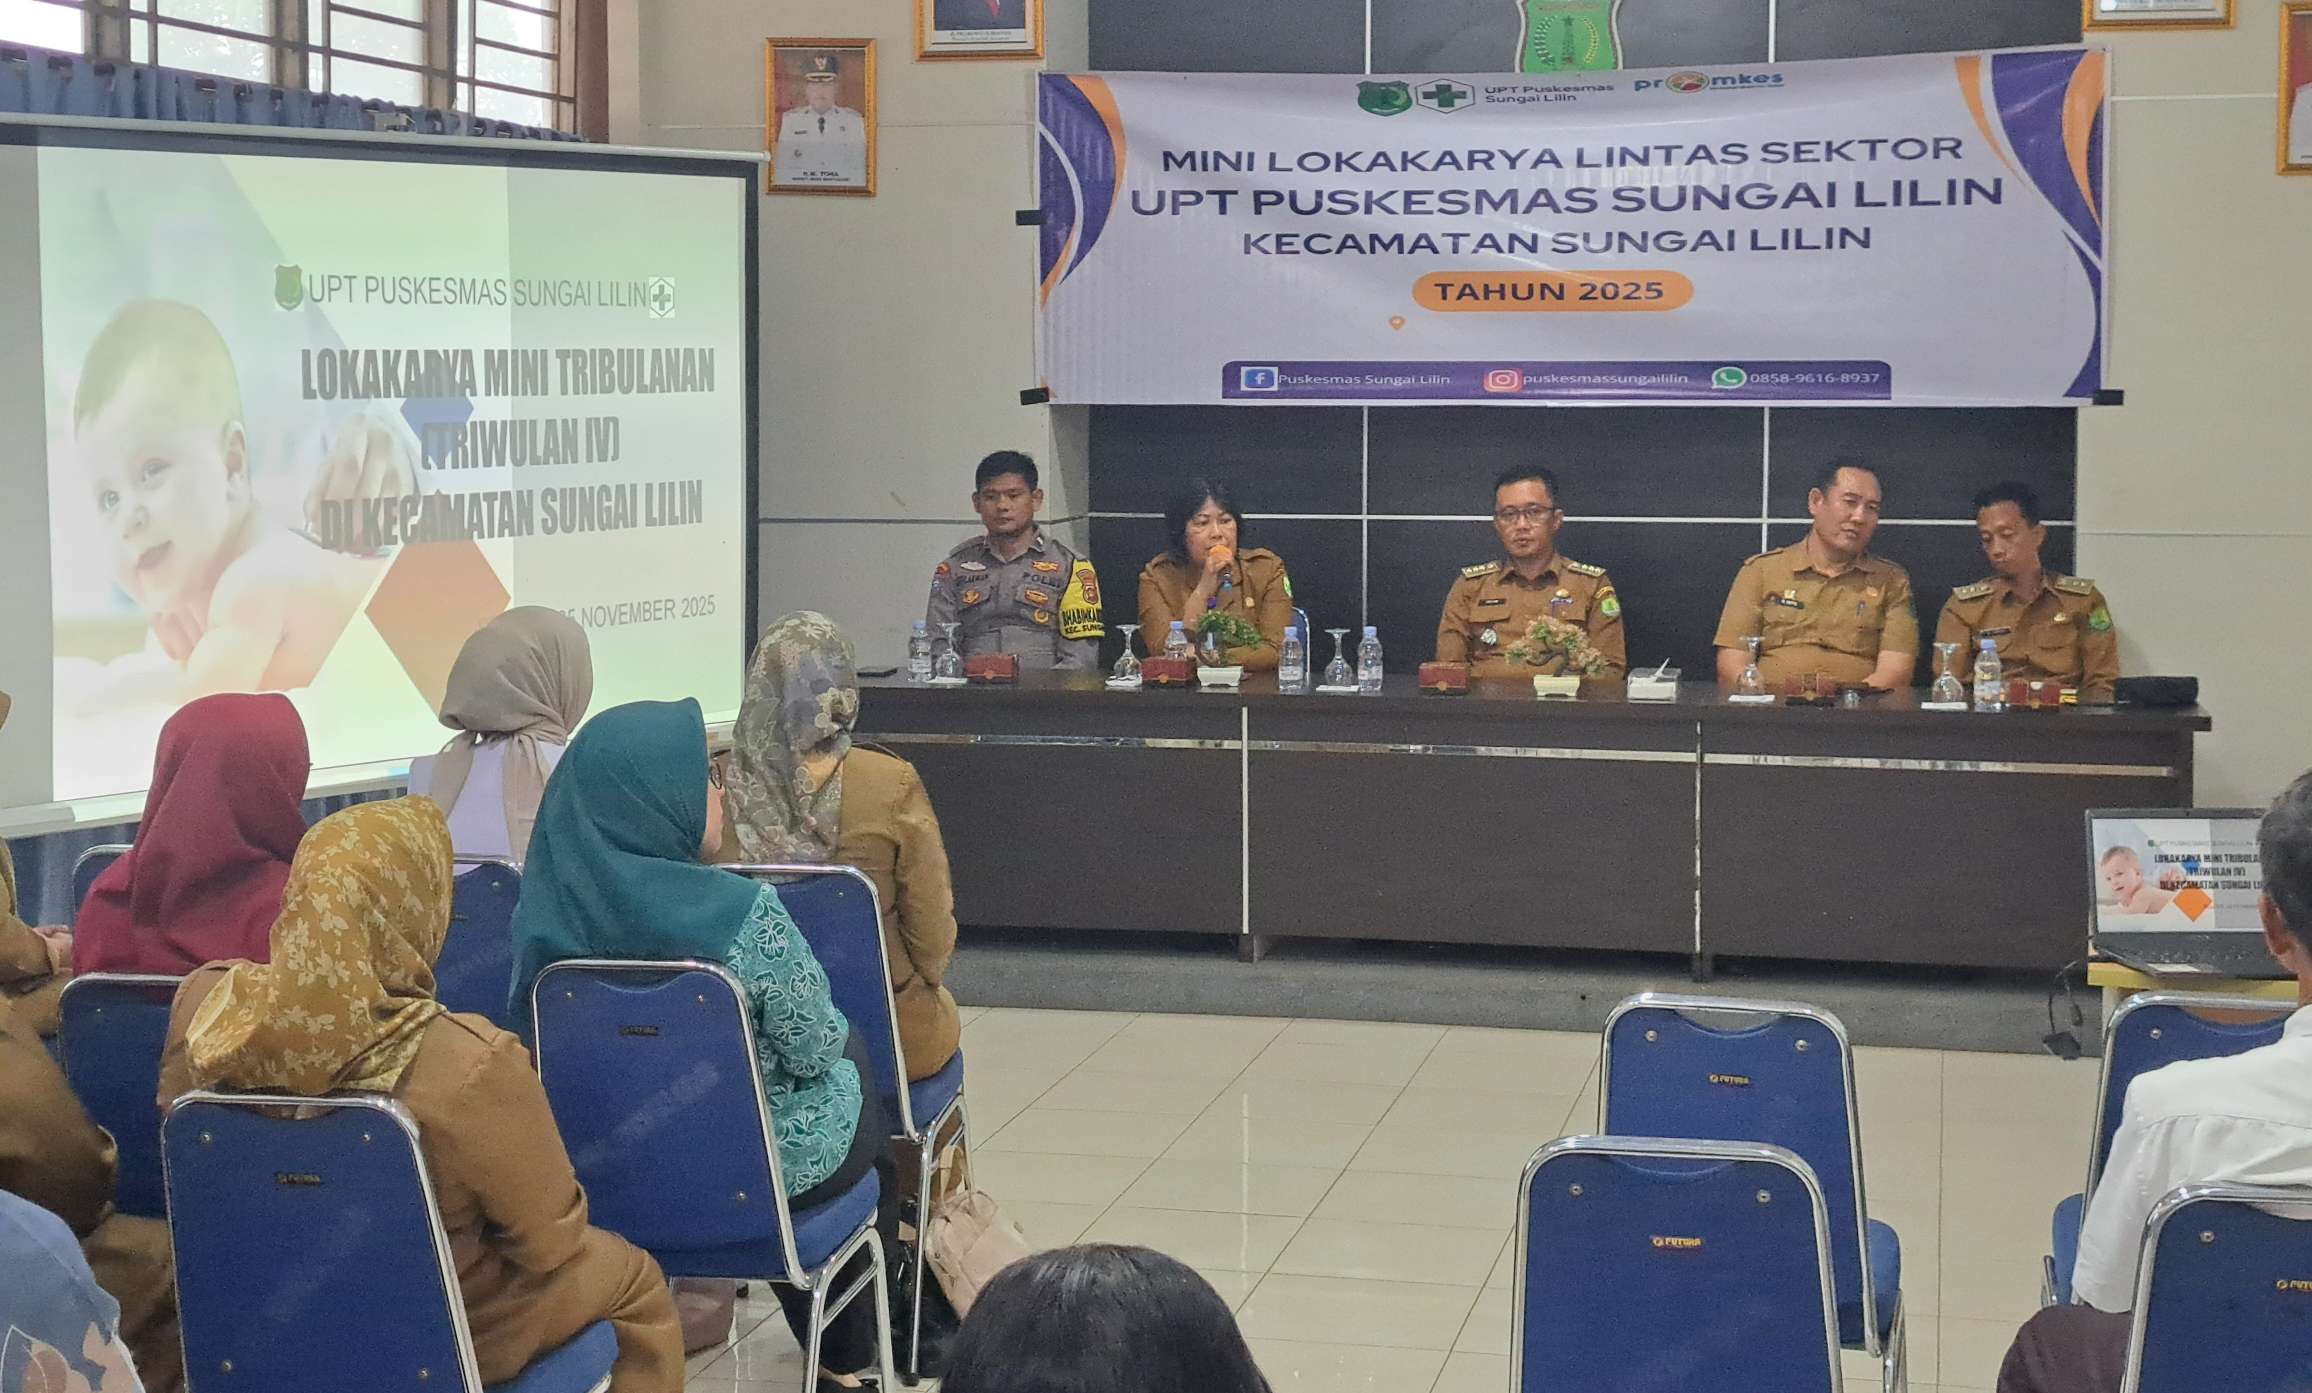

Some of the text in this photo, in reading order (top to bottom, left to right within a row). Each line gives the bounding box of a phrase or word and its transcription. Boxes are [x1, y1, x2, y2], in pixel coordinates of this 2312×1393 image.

[1485, 83, 1614, 94] UPT Puskesmas
[1485, 93, 1577, 104] Sungai Lilin
[1162, 137, 1963, 173] MINI LOKAKARYA LINTAS SEKTOR
[1131, 178, 2003, 216] UPT PUSKESMAS SUNGAI LILIN
[1244, 227, 1872, 256] KECAMATAN SUNGAI LILIN
[309, 275, 647, 306] UPT PUSKESMAS SUNGAI LILIN
[1435, 281, 1664, 301] TAHUN 2025
[301, 347, 715, 400] LOKAKARYA MINI TRIBULANAN
[1278, 372, 1450, 389] Puskesmas Sungai Lilin
[1523, 371, 1688, 388] puskesmassungaililin
[1750, 371, 1880, 386] 0858-9616-8937
[585, 416, 620, 463] IV)
[321, 479, 703, 548] DI KECAMATAN SUNGAI LILIN
[581, 594, 716, 628] NOVEMBER 2025
[1665, 1237, 1701, 1247] FUTURA
